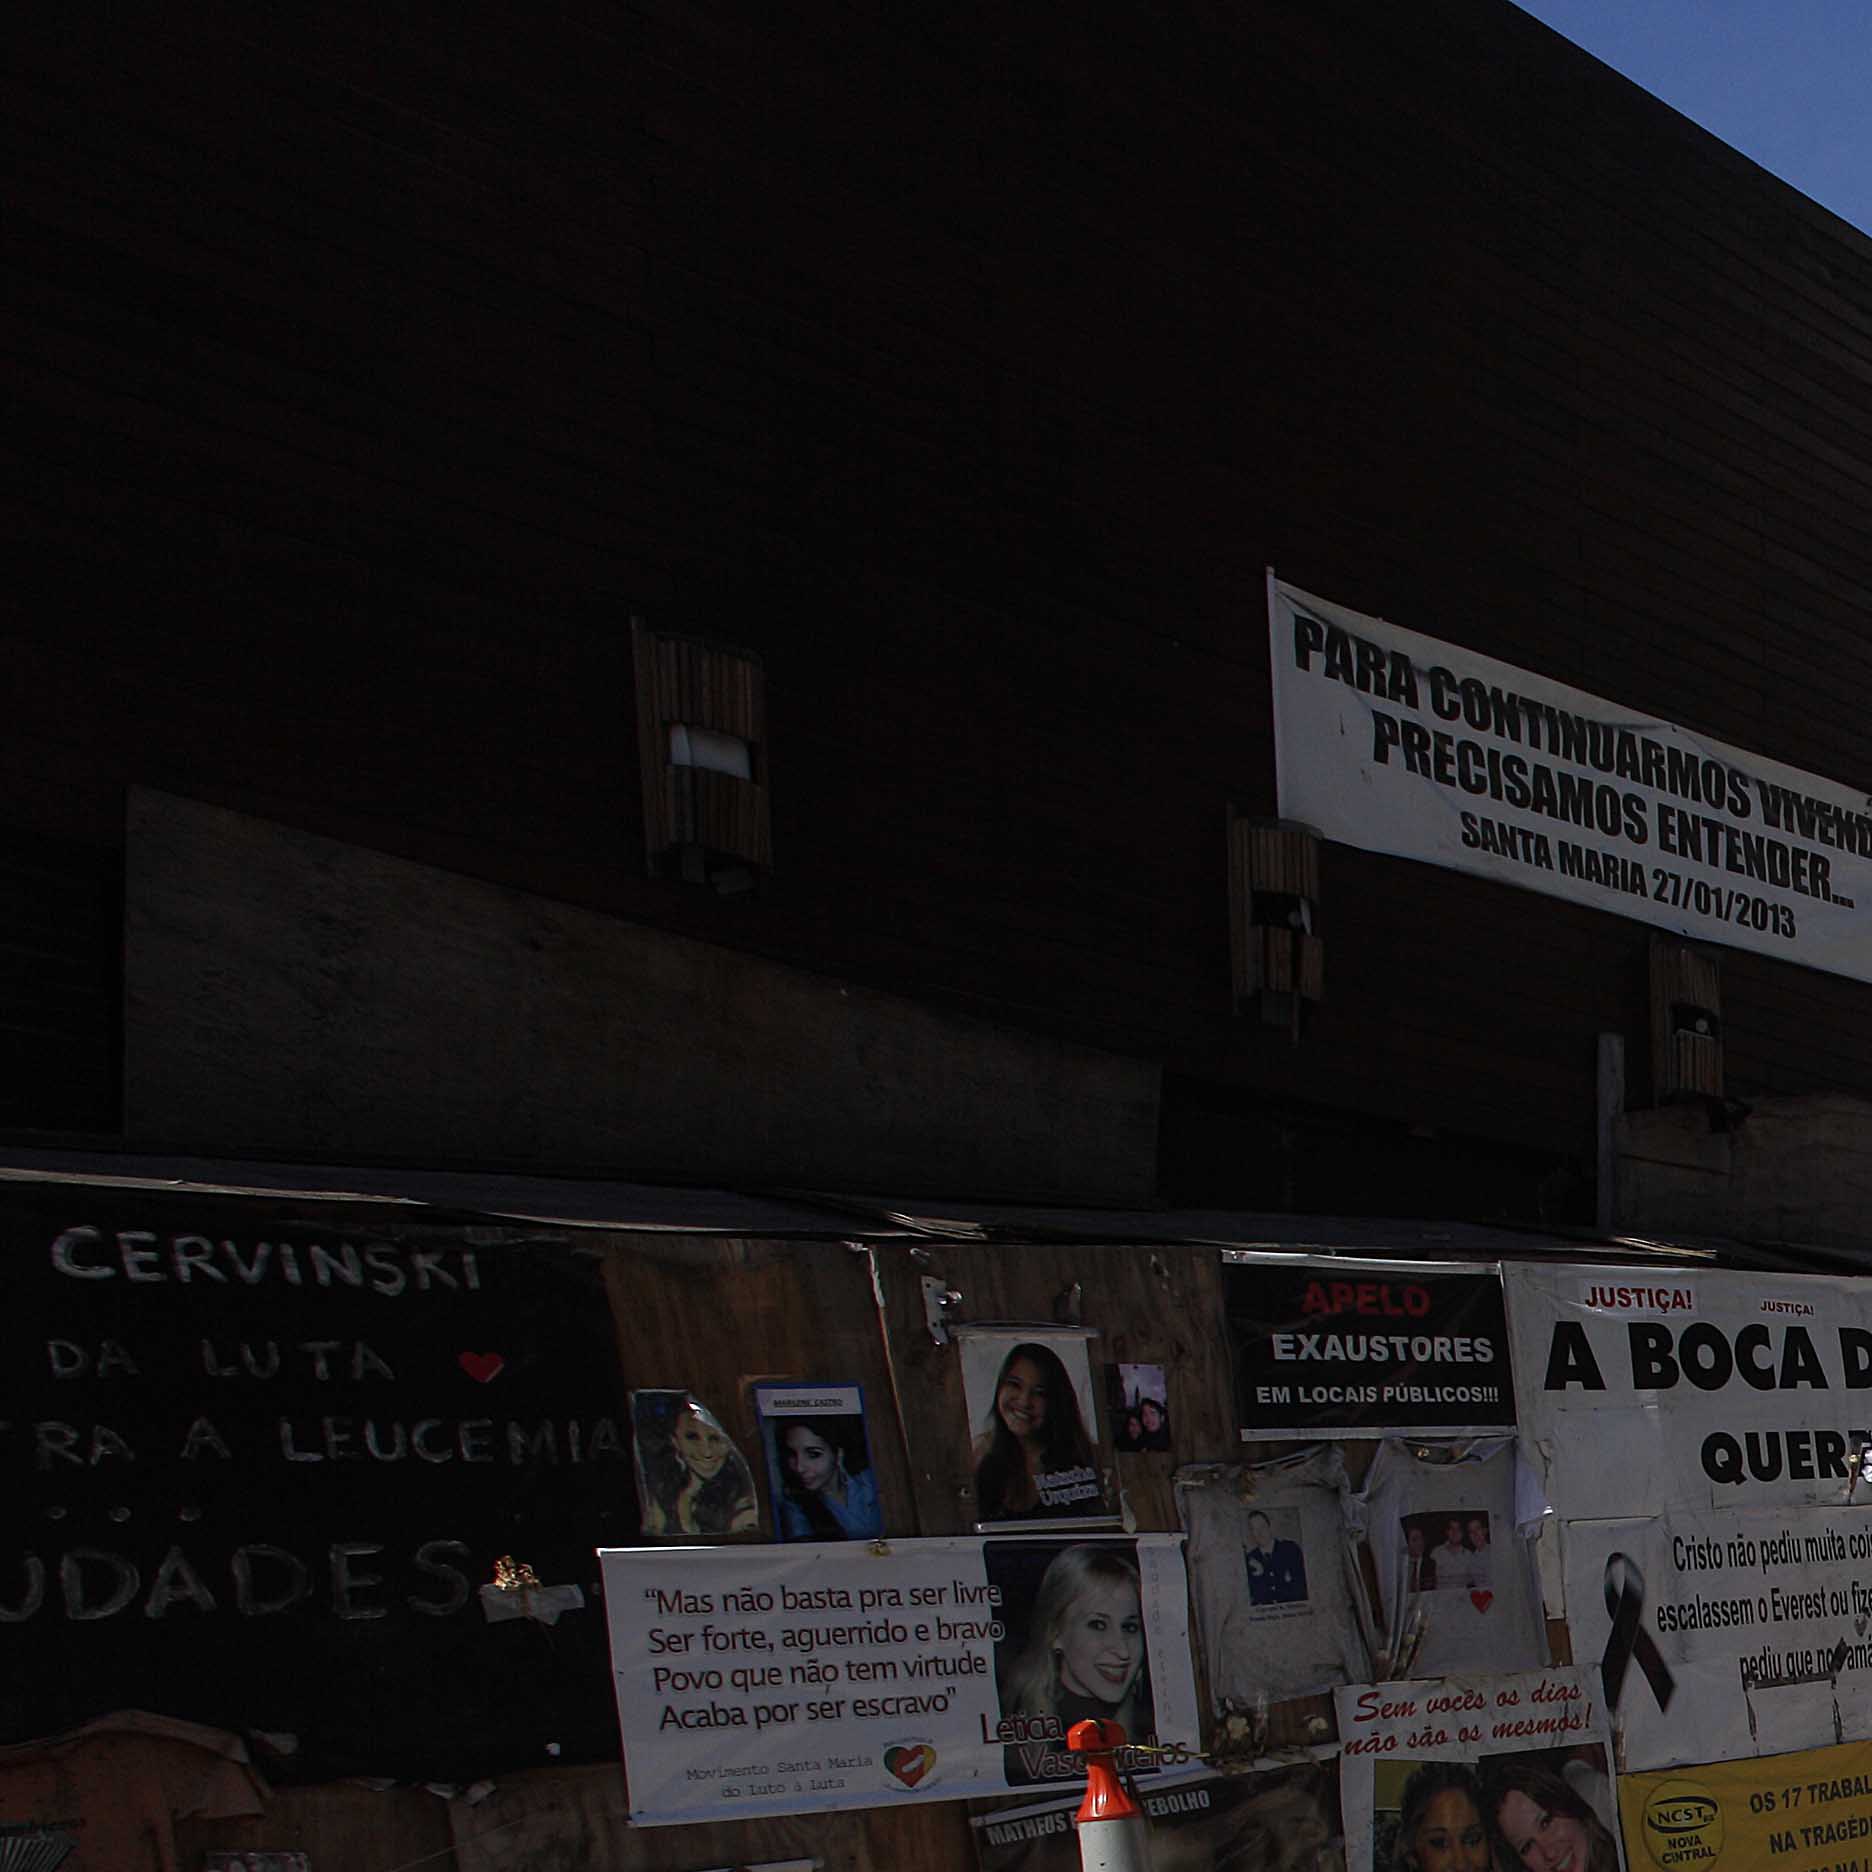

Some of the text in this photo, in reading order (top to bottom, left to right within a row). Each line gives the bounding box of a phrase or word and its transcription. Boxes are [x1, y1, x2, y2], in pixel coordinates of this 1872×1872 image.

[1293, 614, 1418, 709] PARA
[1429, 666, 1751, 819] CONTINUARMOS
[1373, 709, 1854, 908] PRECISAMOS ENTENDER...
[1461, 812, 1796, 940] SANTA MARIA 27/01/2013
[50, 1224, 482, 1297] CERVINSKI
[1302, 1282, 1431, 1316] APELO
[1585, 1286, 1693, 1314] JUSTIÇA!
[1760, 1301, 1815, 1317] JUSTIÇA!
[48, 1339, 395, 1380] DA LUTA
[1272, 1334, 1495, 1363] EXAUSTORES
[1544, 1321, 1605, 1391] A
[1629, 1322, 1830, 1391] BOCA
[1256, 1381, 1499, 1403] EM LOCAIS PÚBLICOS!!!
[180, 1416, 626, 1465] A LEUCEMIA
[1673, 1534, 1723, 1571] Cristo
[1727, 1533, 1756, 1568] não
[1761, 1530, 1802, 1573] pediu
[1805, 1527, 1845, 1563] muita
[723, 1587, 773, 1612] não
[782, 1585, 851, 1610] basta
[861, 1585, 900, 1612] pra
[911, 1585, 947, 1606] ser
[953, 1580, 1002, 1606] livre
[1657, 1598, 1754, 1633] escalassem
[1758, 1604, 1768, 1622] o
[1771, 1587, 1827, 1620] Everest
[1830, 1592, 1849, 1617] ou
[649, 1617, 1005, 1653] Ser forte, aguerrido e bravo
[653, 1651, 986, 1692] Povo que não tem virtude
[660, 1702, 748, 1730] Acaba
[754, 1702, 799, 1729] por
[807, 1698, 844, 1719] ser
[1354, 1680, 1582, 1722] Sem vocês os dias
[1344, 1703, 1592, 1755] não são os mesmos!
[1658, 1807, 1704, 1824] NCST
[1749, 1793, 1776, 1815] OS
[1781, 1789, 1802, 1809] 17
[986, 1817, 1068, 1846] MATHEUS
[1668, 1835, 1701, 1848] NOVA
[1770, 1832, 1797, 1856] NA
